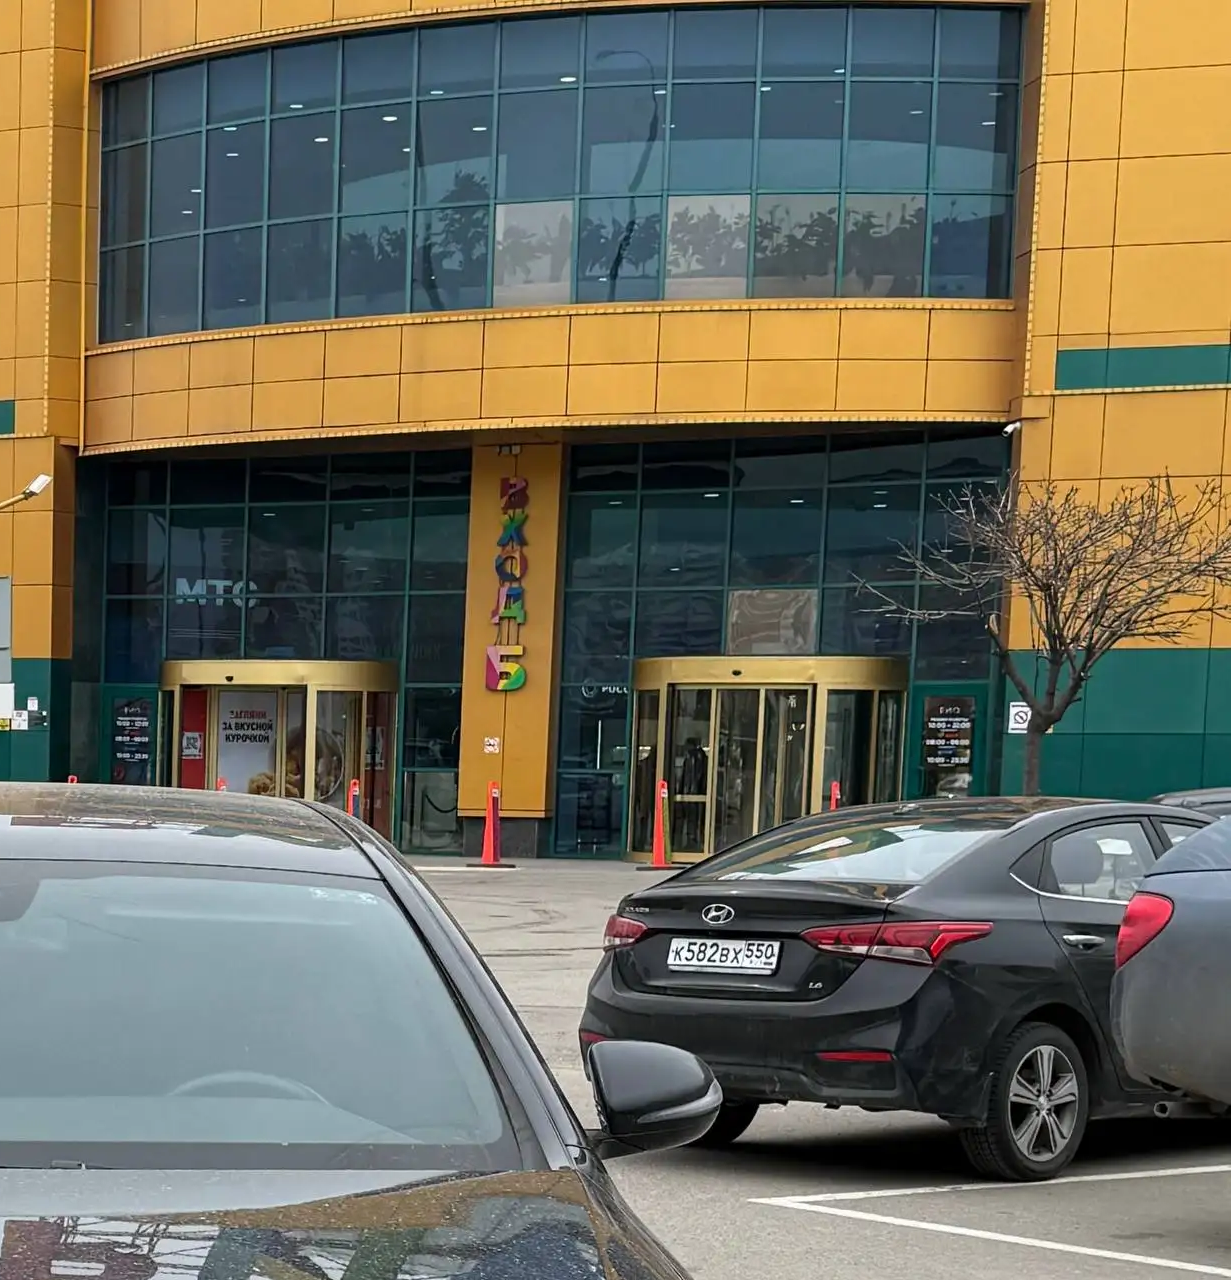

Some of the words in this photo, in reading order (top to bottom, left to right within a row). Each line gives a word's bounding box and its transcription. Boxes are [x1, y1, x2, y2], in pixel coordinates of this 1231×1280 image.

[491, 477, 529, 625] ВХОД
[175, 577, 258, 608] МТС
[485, 645, 527, 692] Б
[222, 721, 233, 731] ЗА
[234, 719, 274, 731] ВКУСНОЙ
[225, 731, 270, 743] КУРОЧКОЙ
[673, 941, 743, 964] К582ВХ
[745, 942, 774, 960] 550
